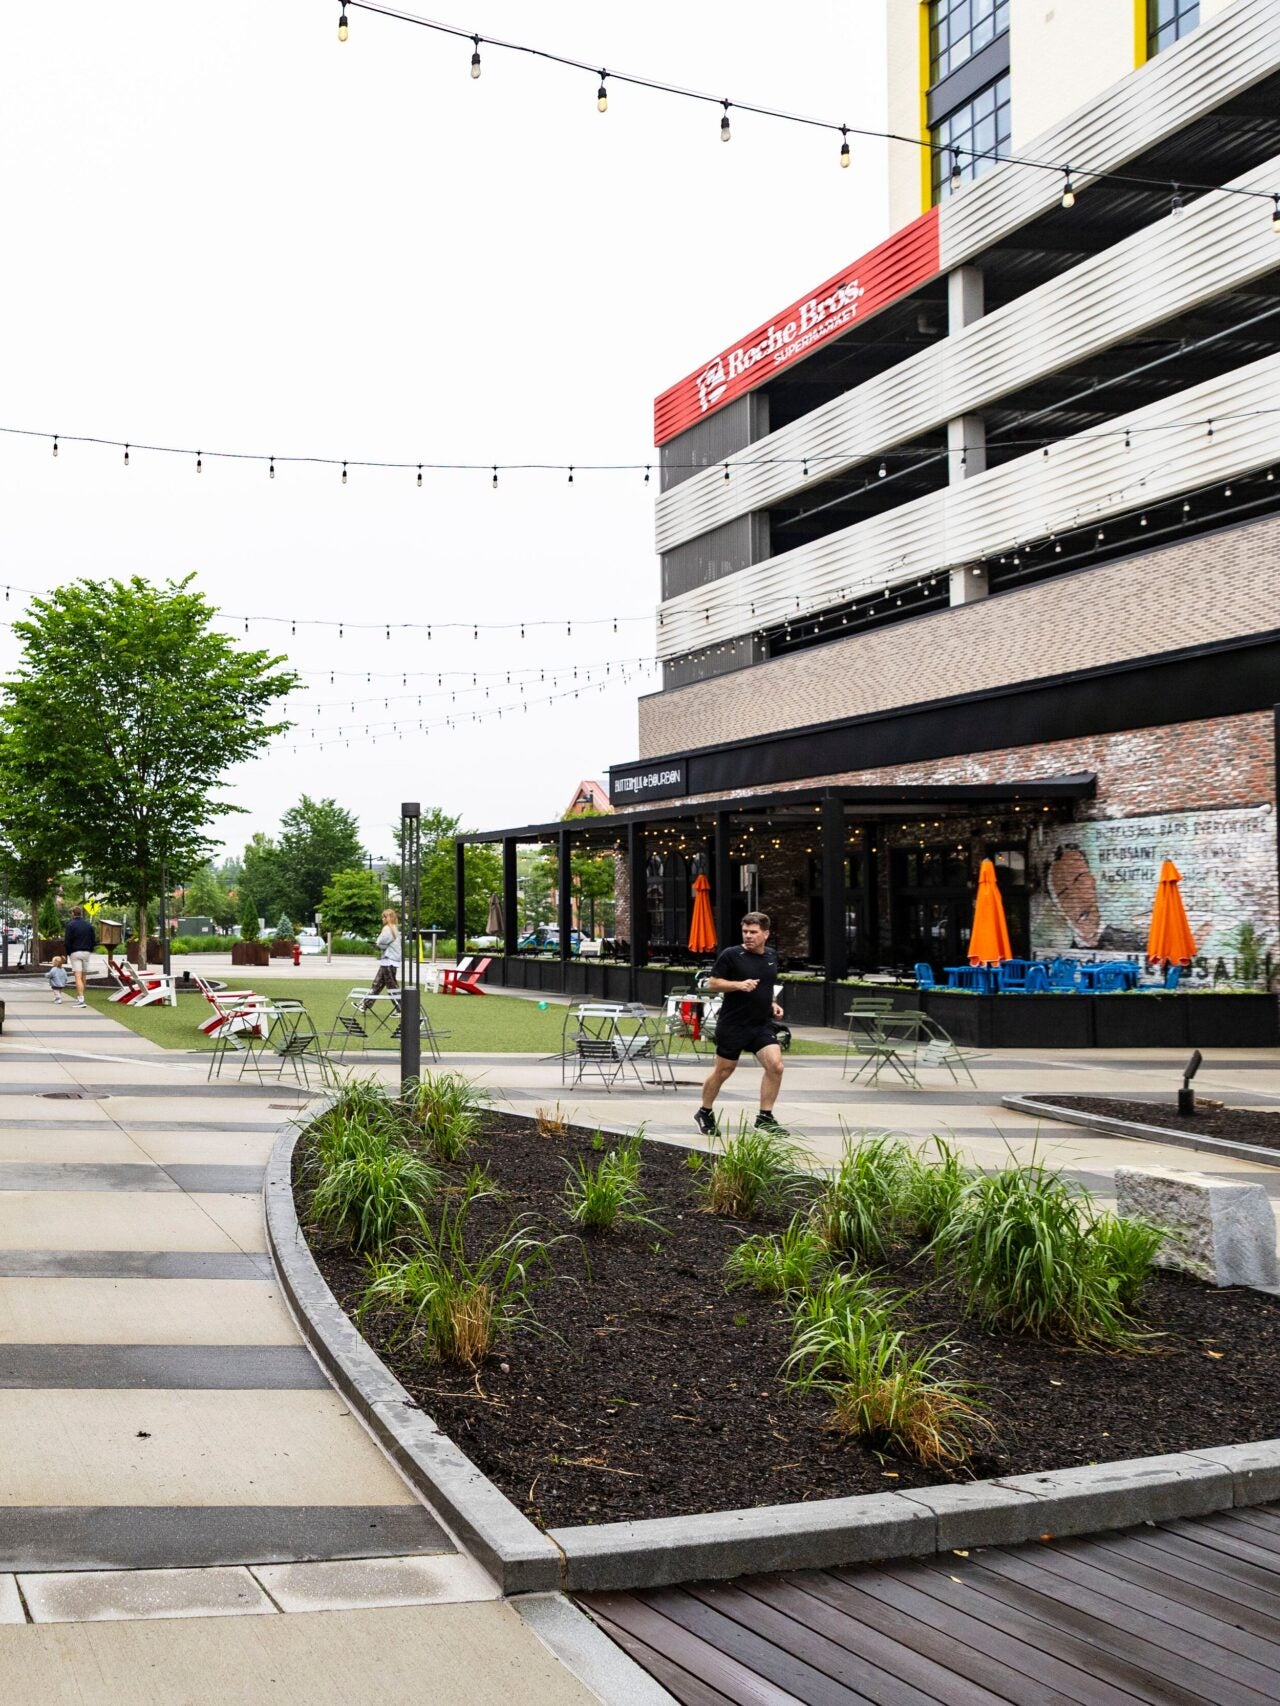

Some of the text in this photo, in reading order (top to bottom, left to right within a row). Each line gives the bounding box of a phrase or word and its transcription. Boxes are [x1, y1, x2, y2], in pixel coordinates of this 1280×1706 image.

[726, 279, 864, 381] Roche Bros.
[773, 303, 858, 366] SUPERMARKET
[648, 769, 681, 788] BOURBON
